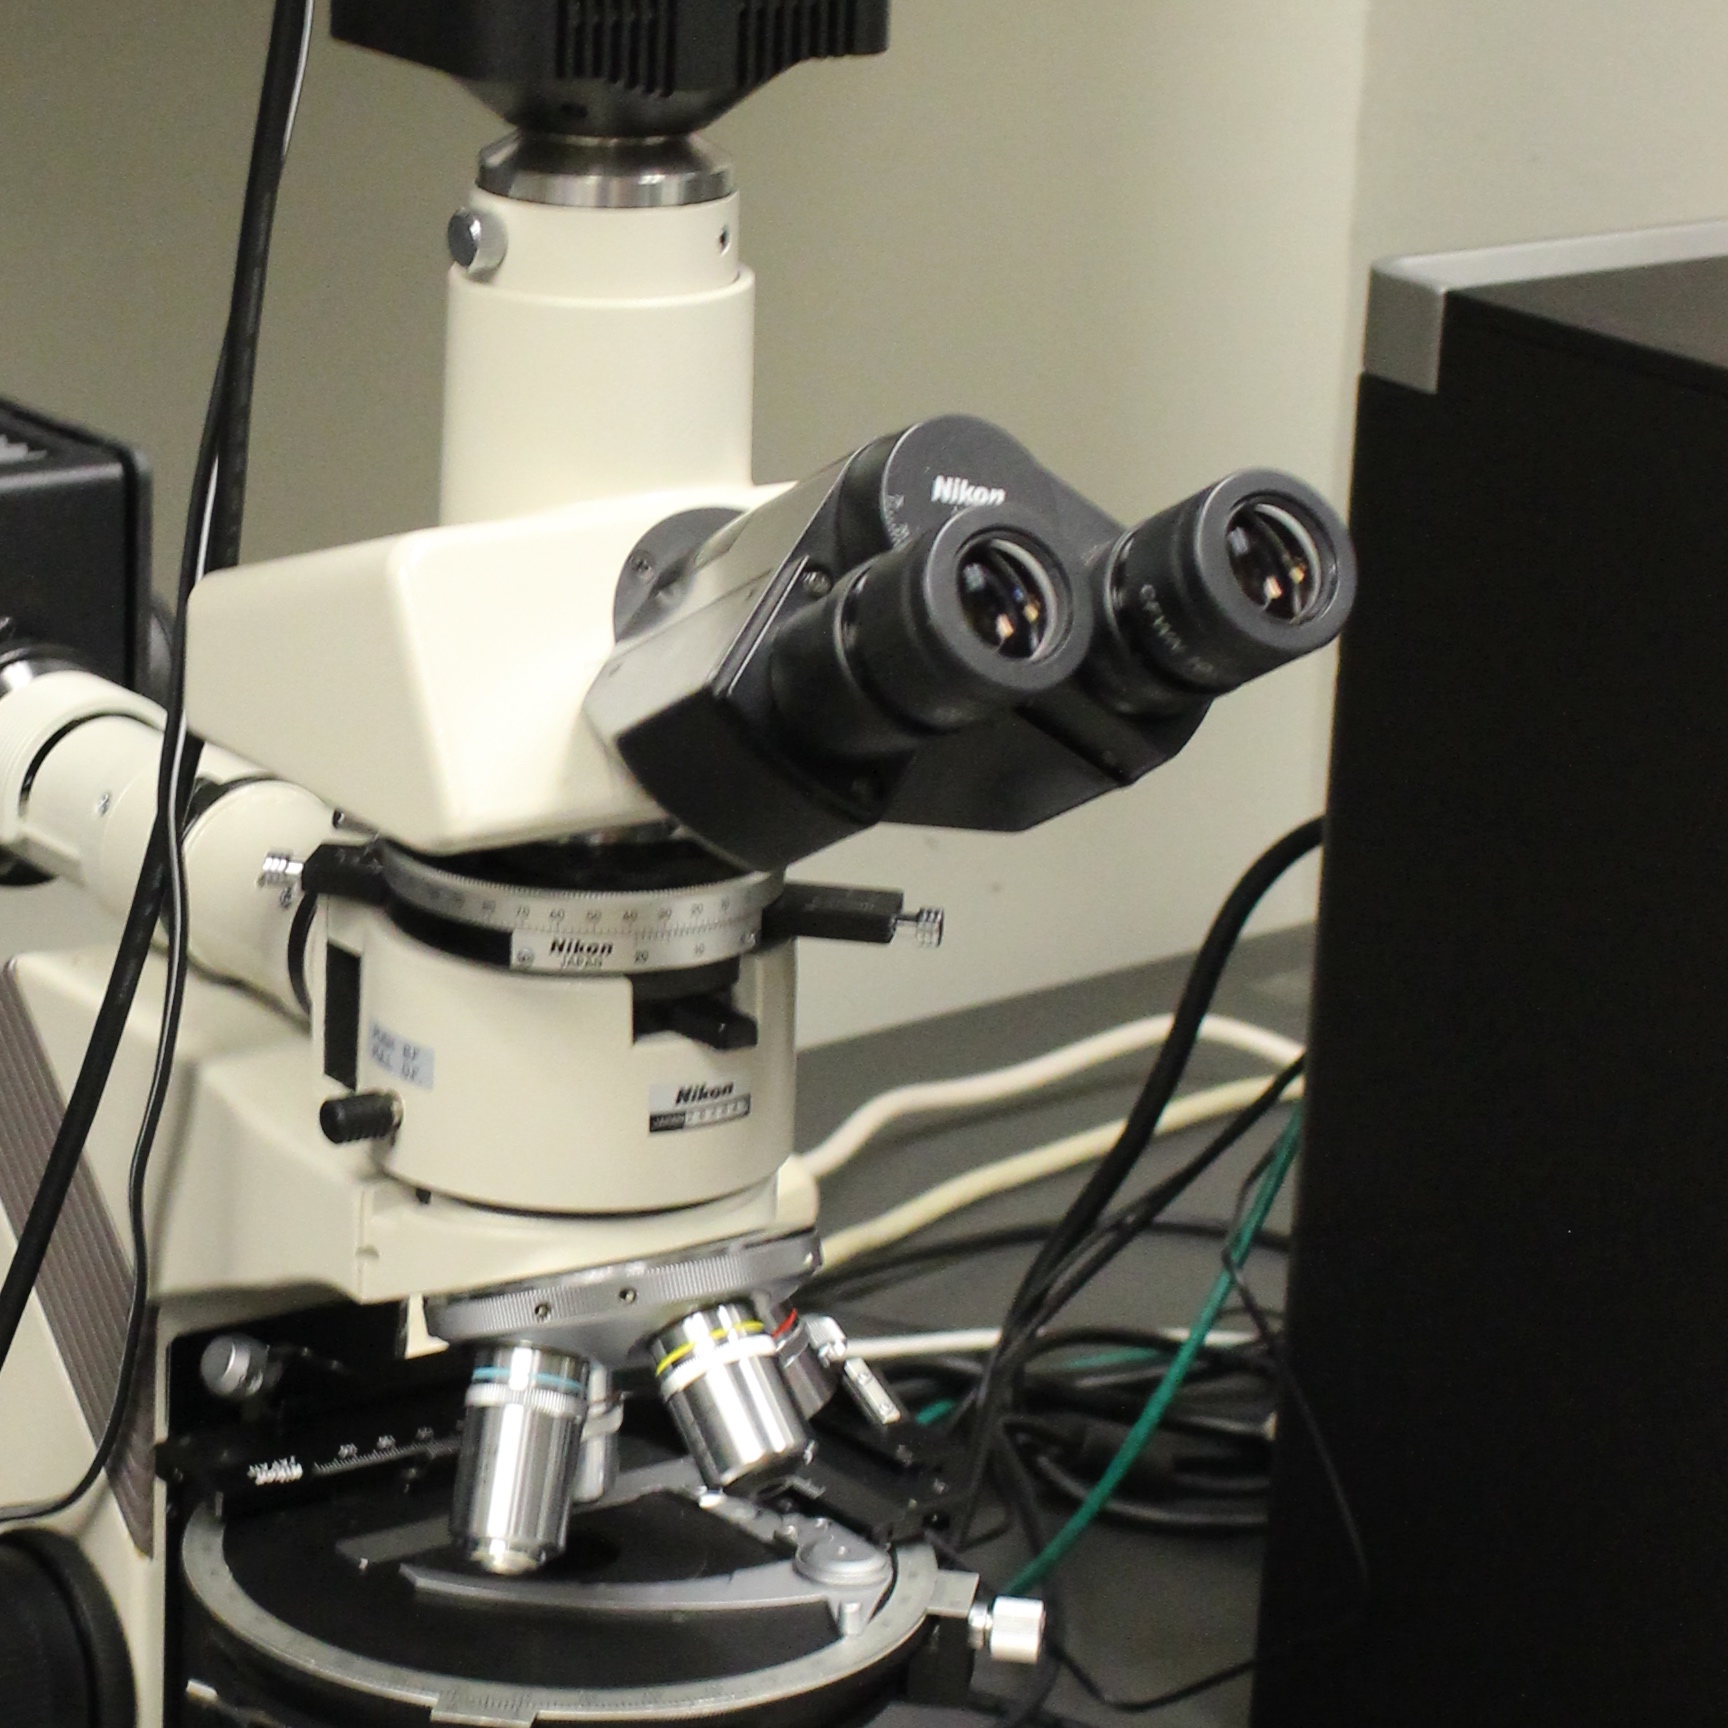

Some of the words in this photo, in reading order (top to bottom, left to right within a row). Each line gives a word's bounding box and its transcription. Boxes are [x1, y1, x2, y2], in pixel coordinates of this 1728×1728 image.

[931, 475, 1007, 507] Nikon
[549, 936, 614, 957] Nikon
[675, 1081, 735, 1105] Nikon
